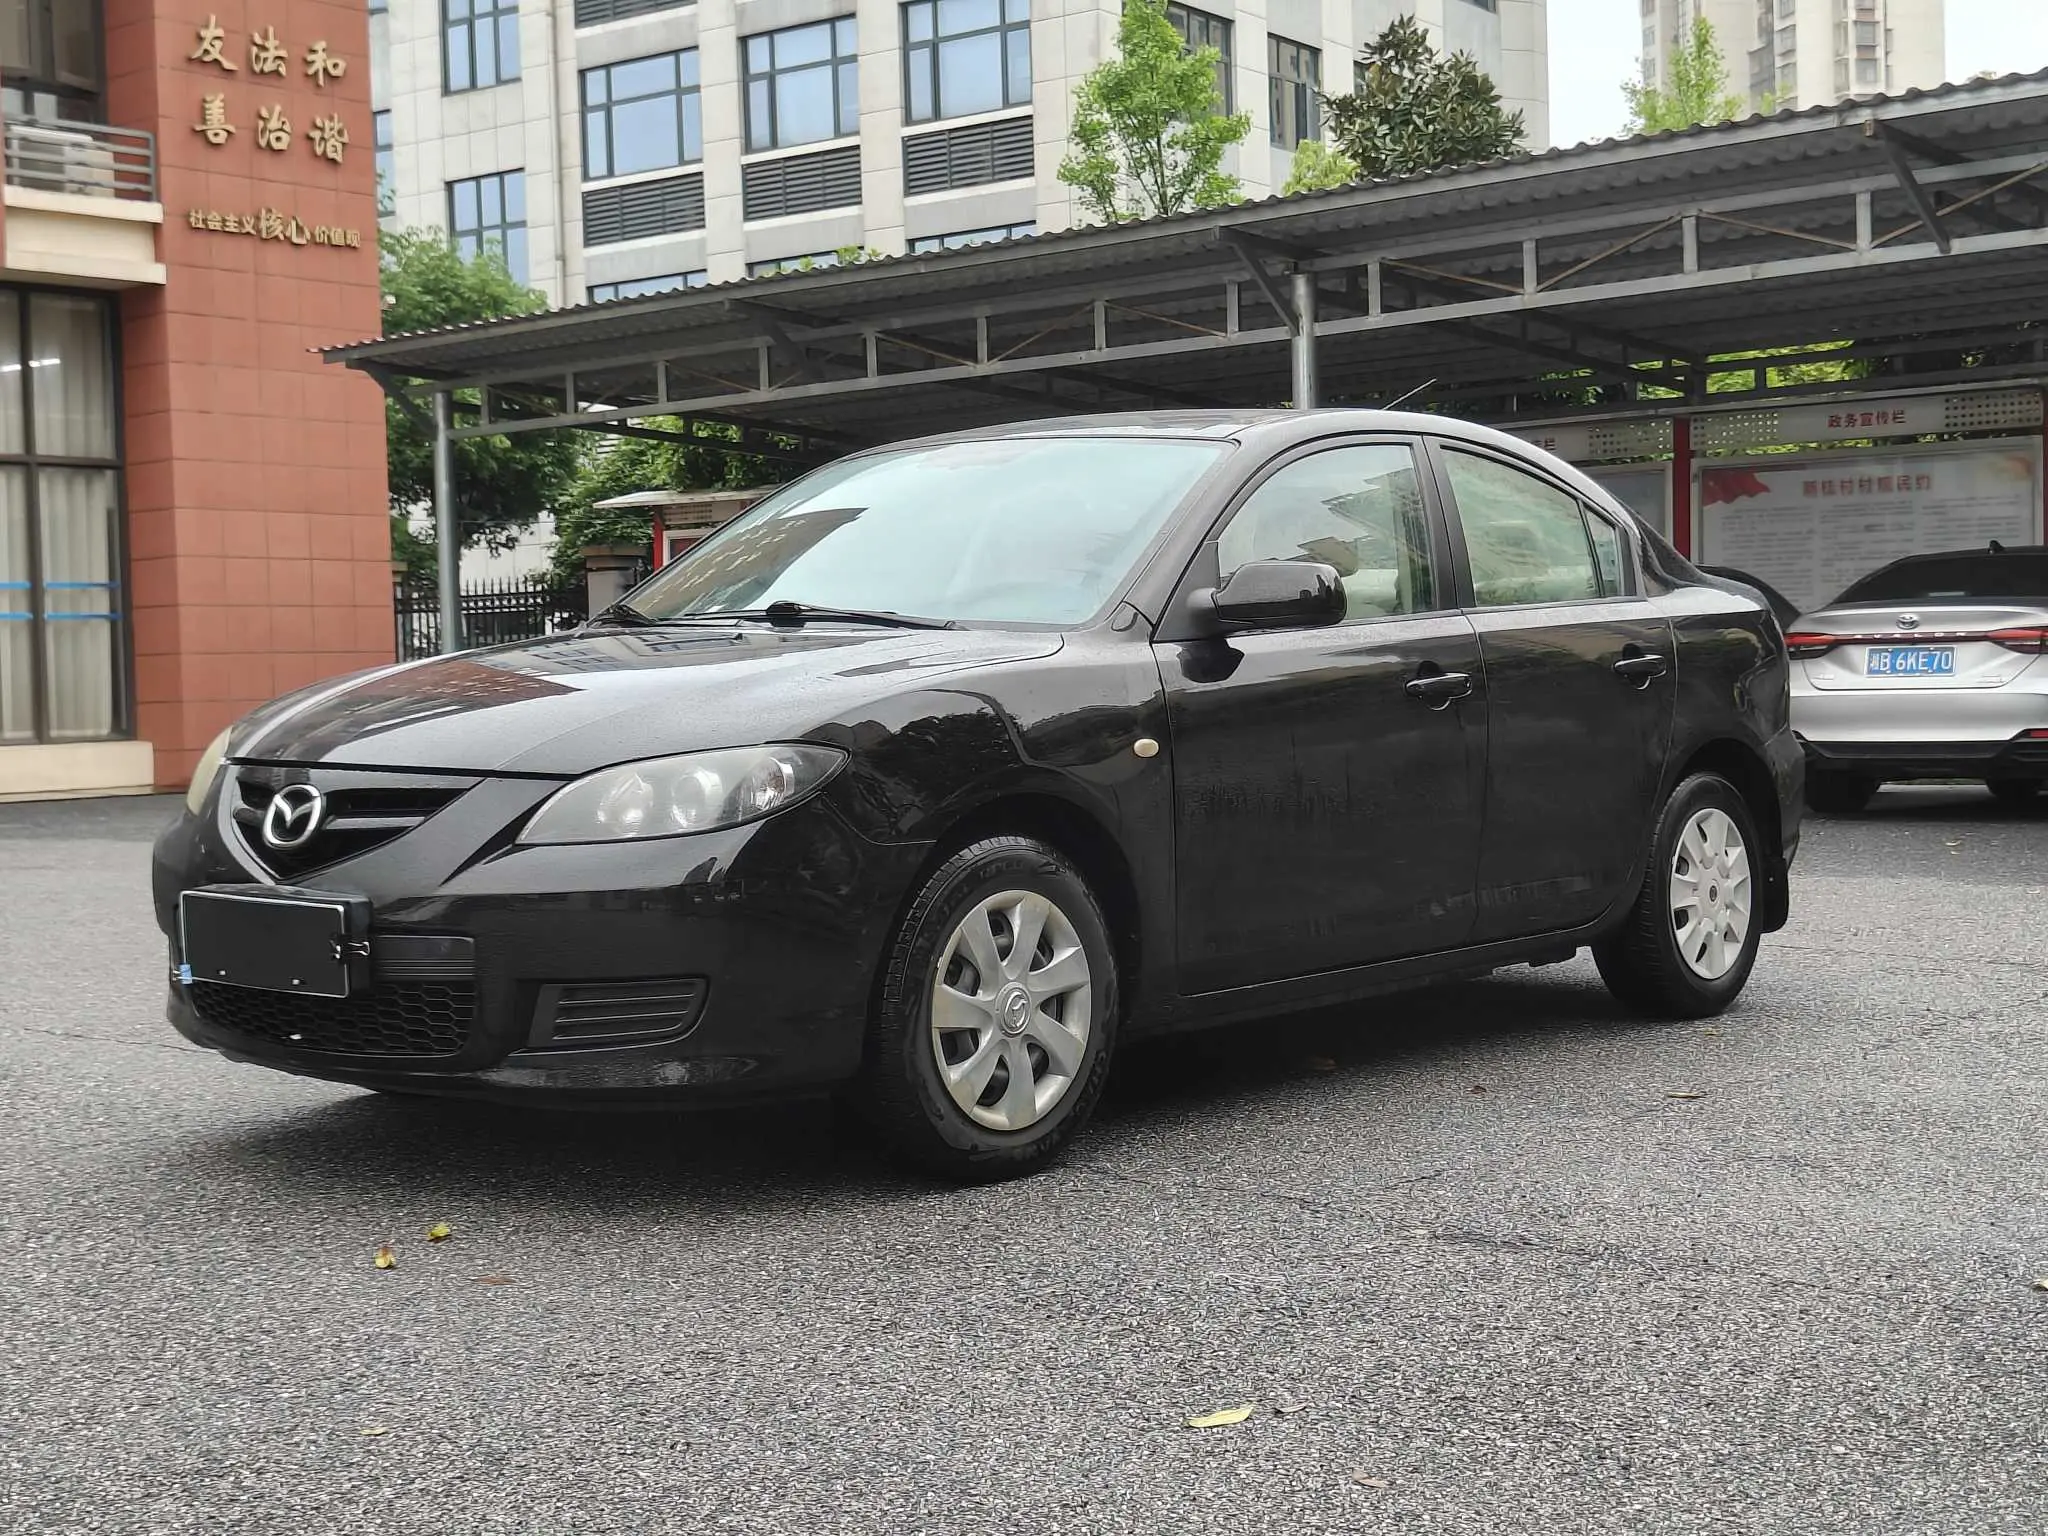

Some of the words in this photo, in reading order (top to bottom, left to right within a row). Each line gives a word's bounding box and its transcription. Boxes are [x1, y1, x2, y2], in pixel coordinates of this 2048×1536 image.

[1827, 409, 1907, 428] 政务宣传栏
